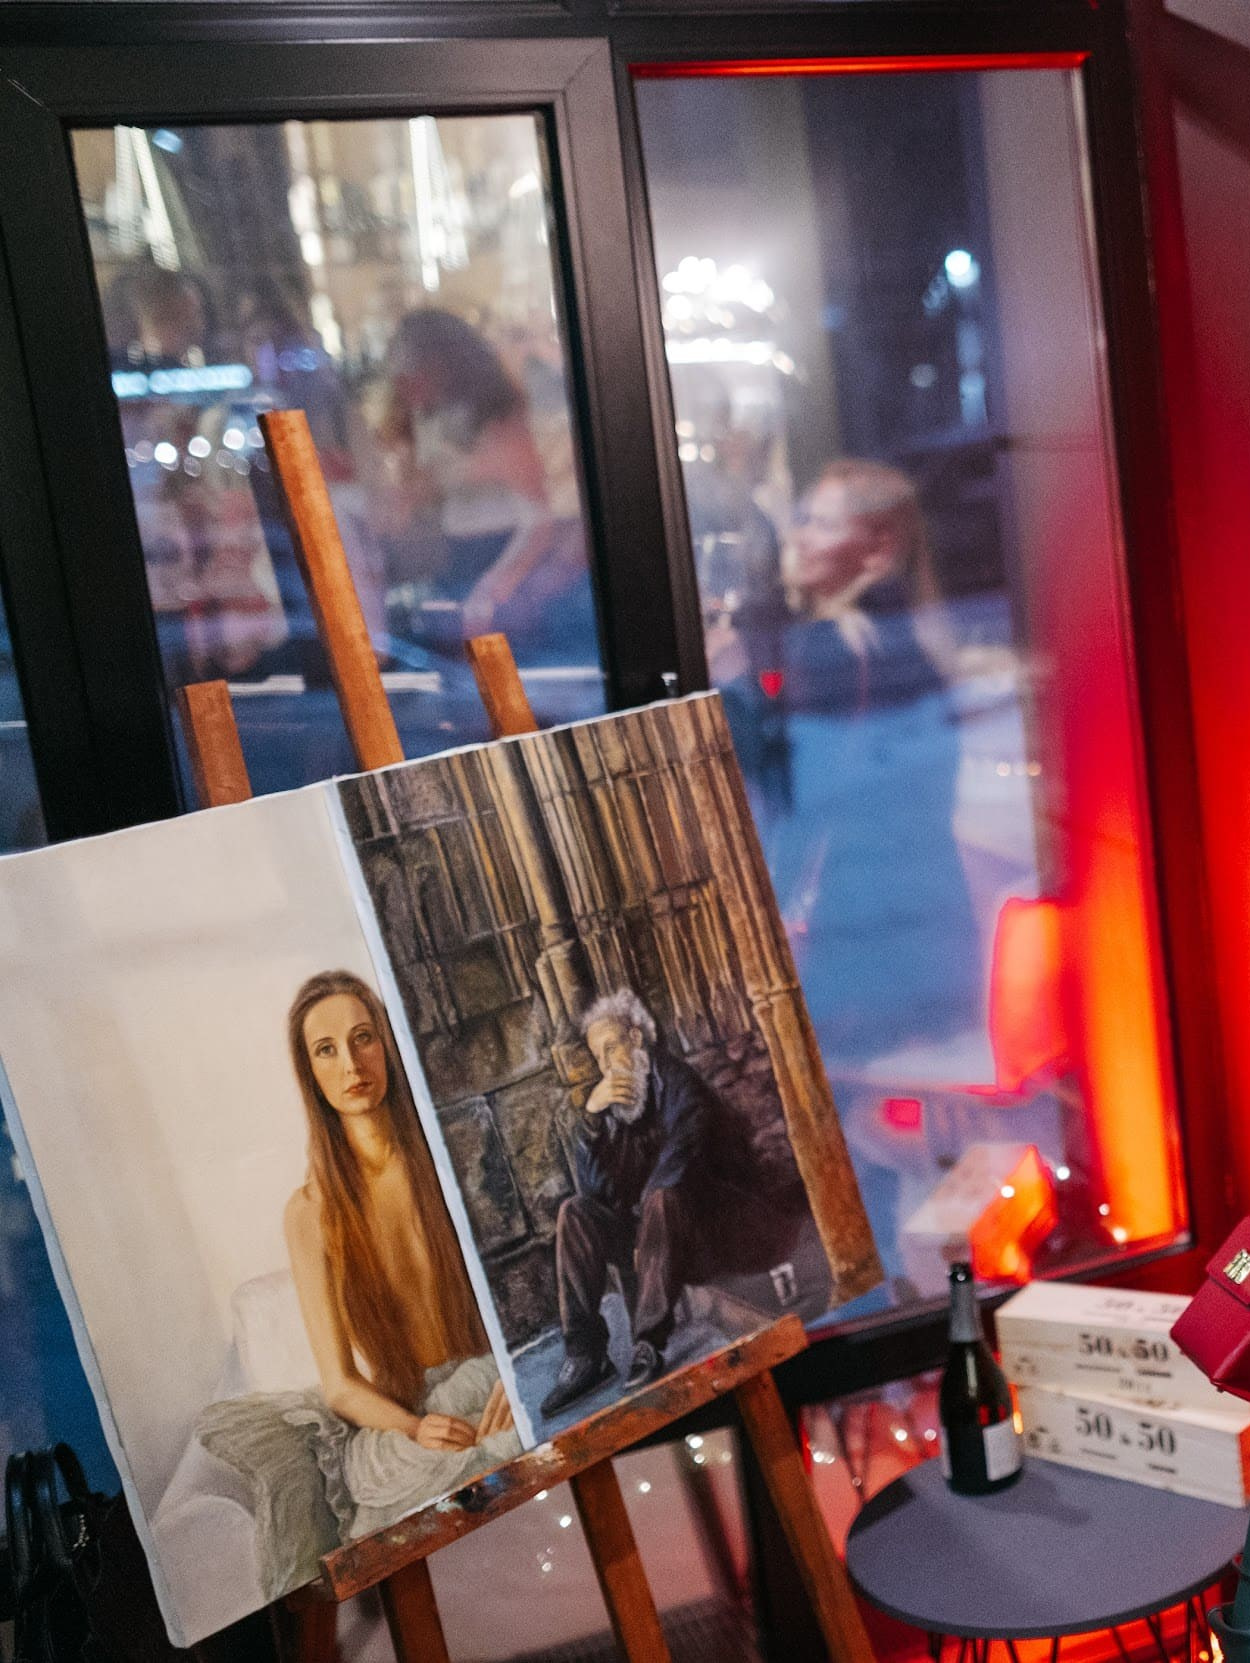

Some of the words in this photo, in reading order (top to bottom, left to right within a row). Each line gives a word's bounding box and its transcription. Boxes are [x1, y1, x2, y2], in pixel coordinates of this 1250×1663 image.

[1078, 1333, 1113, 1356] 50
[1133, 1338, 1169, 1361] 50
[1075, 1407, 1113, 1440] 50
[1138, 1421, 1177, 1455] 50
